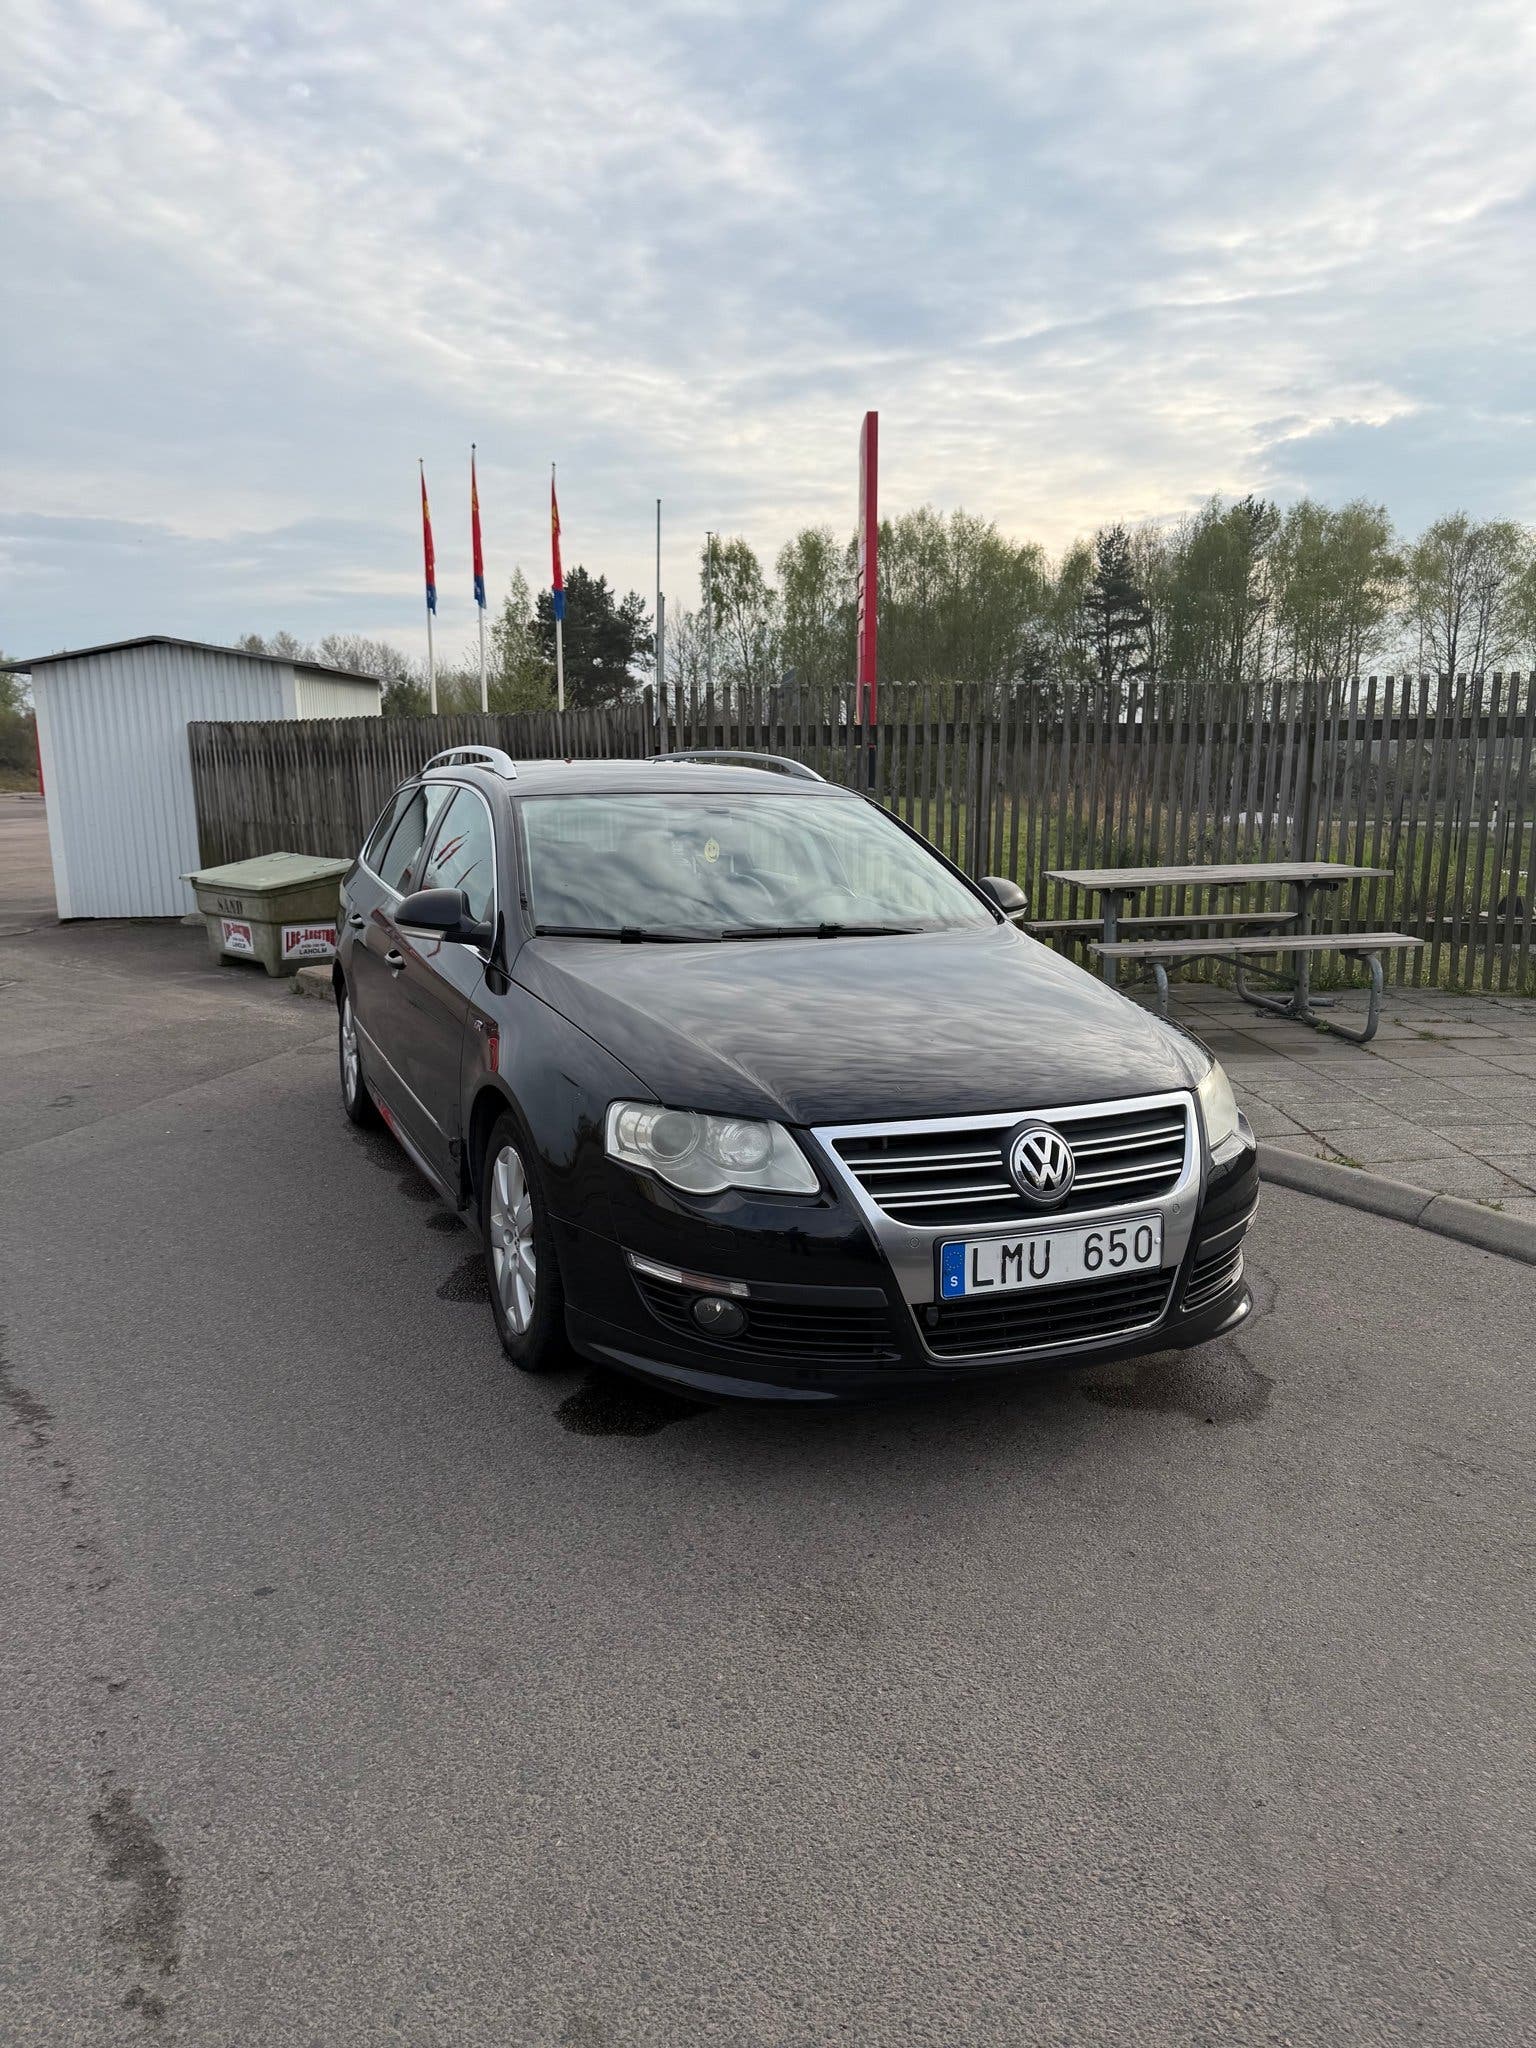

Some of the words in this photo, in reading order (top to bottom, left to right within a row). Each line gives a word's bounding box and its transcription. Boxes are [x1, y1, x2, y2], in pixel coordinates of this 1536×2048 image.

[217, 897, 243, 915] SAND
[299, 947, 328, 955] LAHOLM
[972, 1239, 1051, 1288] LMU
[1084, 1224, 1153, 1272] 650
[950, 1275, 958, 1287] S
